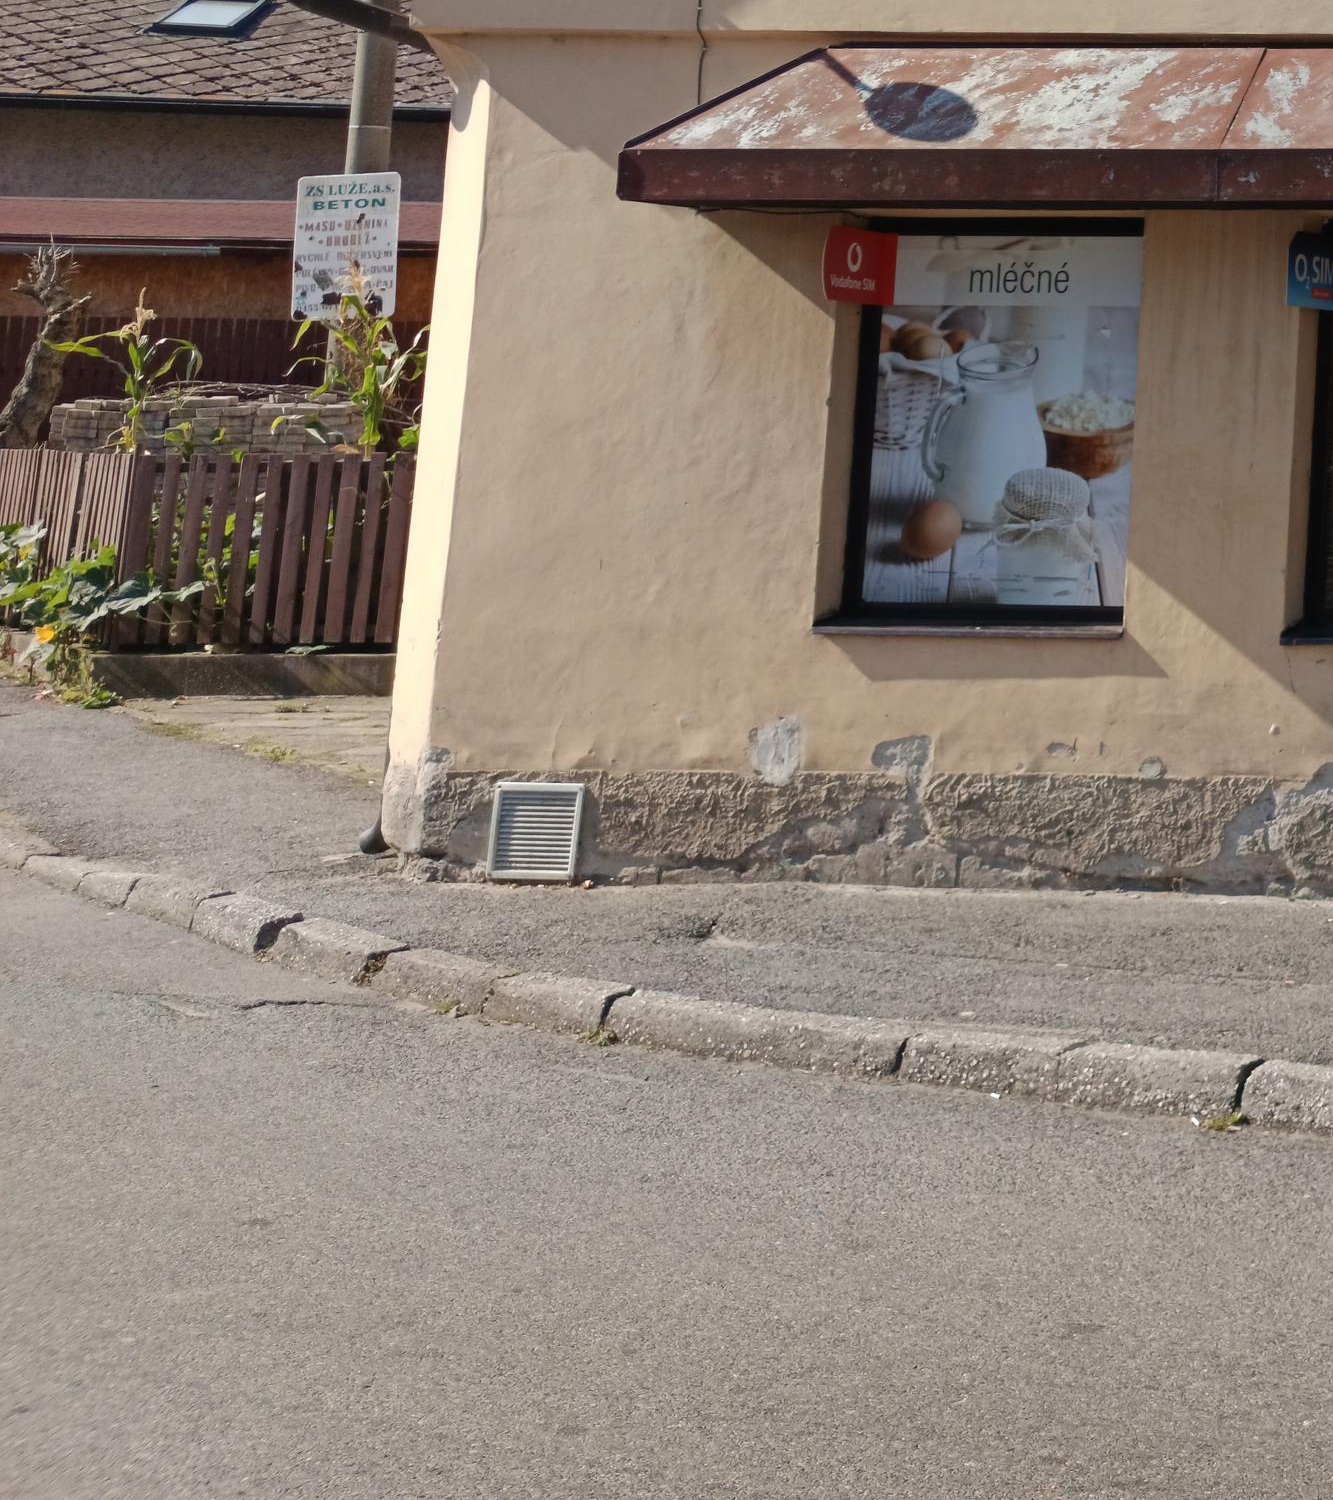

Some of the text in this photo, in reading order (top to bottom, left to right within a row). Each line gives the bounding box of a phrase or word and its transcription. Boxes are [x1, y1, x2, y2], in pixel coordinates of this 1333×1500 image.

[313, 198, 386, 210] BETON
[830, 274, 876, 291] Vodafone SIM
[968, 261, 1070, 294] mléčné
